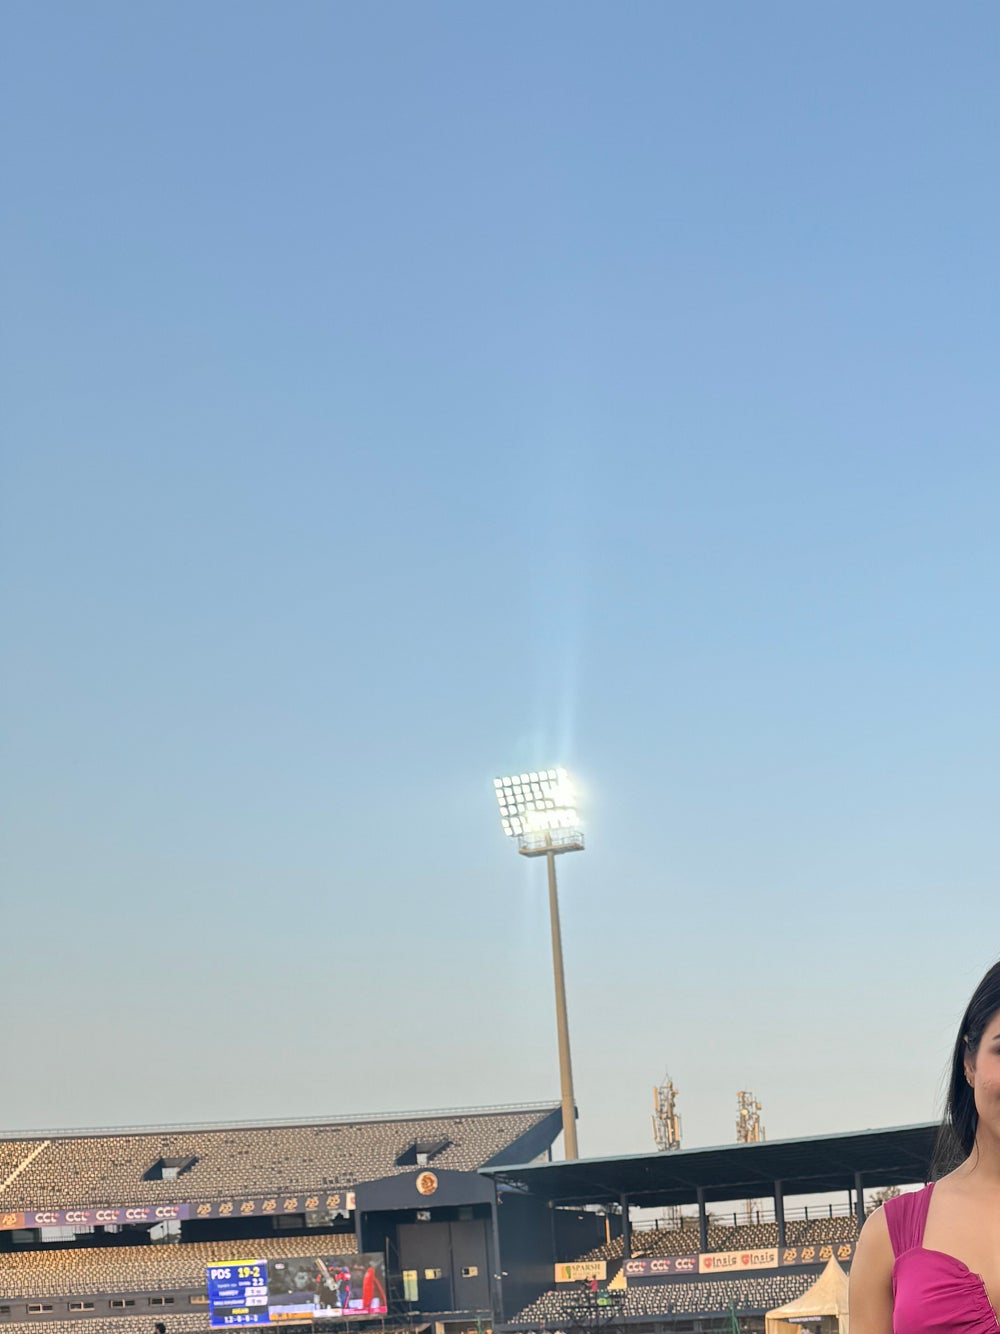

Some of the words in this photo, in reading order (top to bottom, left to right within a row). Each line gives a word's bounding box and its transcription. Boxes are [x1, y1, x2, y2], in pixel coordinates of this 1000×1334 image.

[35, 1213, 58, 1223] CCL
[65, 1211, 88, 1222] CCL
[96, 1210, 118, 1221] CCL
[126, 1209, 148, 1219] CCL
[155, 1207, 177, 1217] CCL
[626, 1262, 643, 1272] CCL
[650, 1260, 667, 1270] CCL
[675, 1259, 692, 1269] CCL
[210, 1268, 231, 1280] PDS
